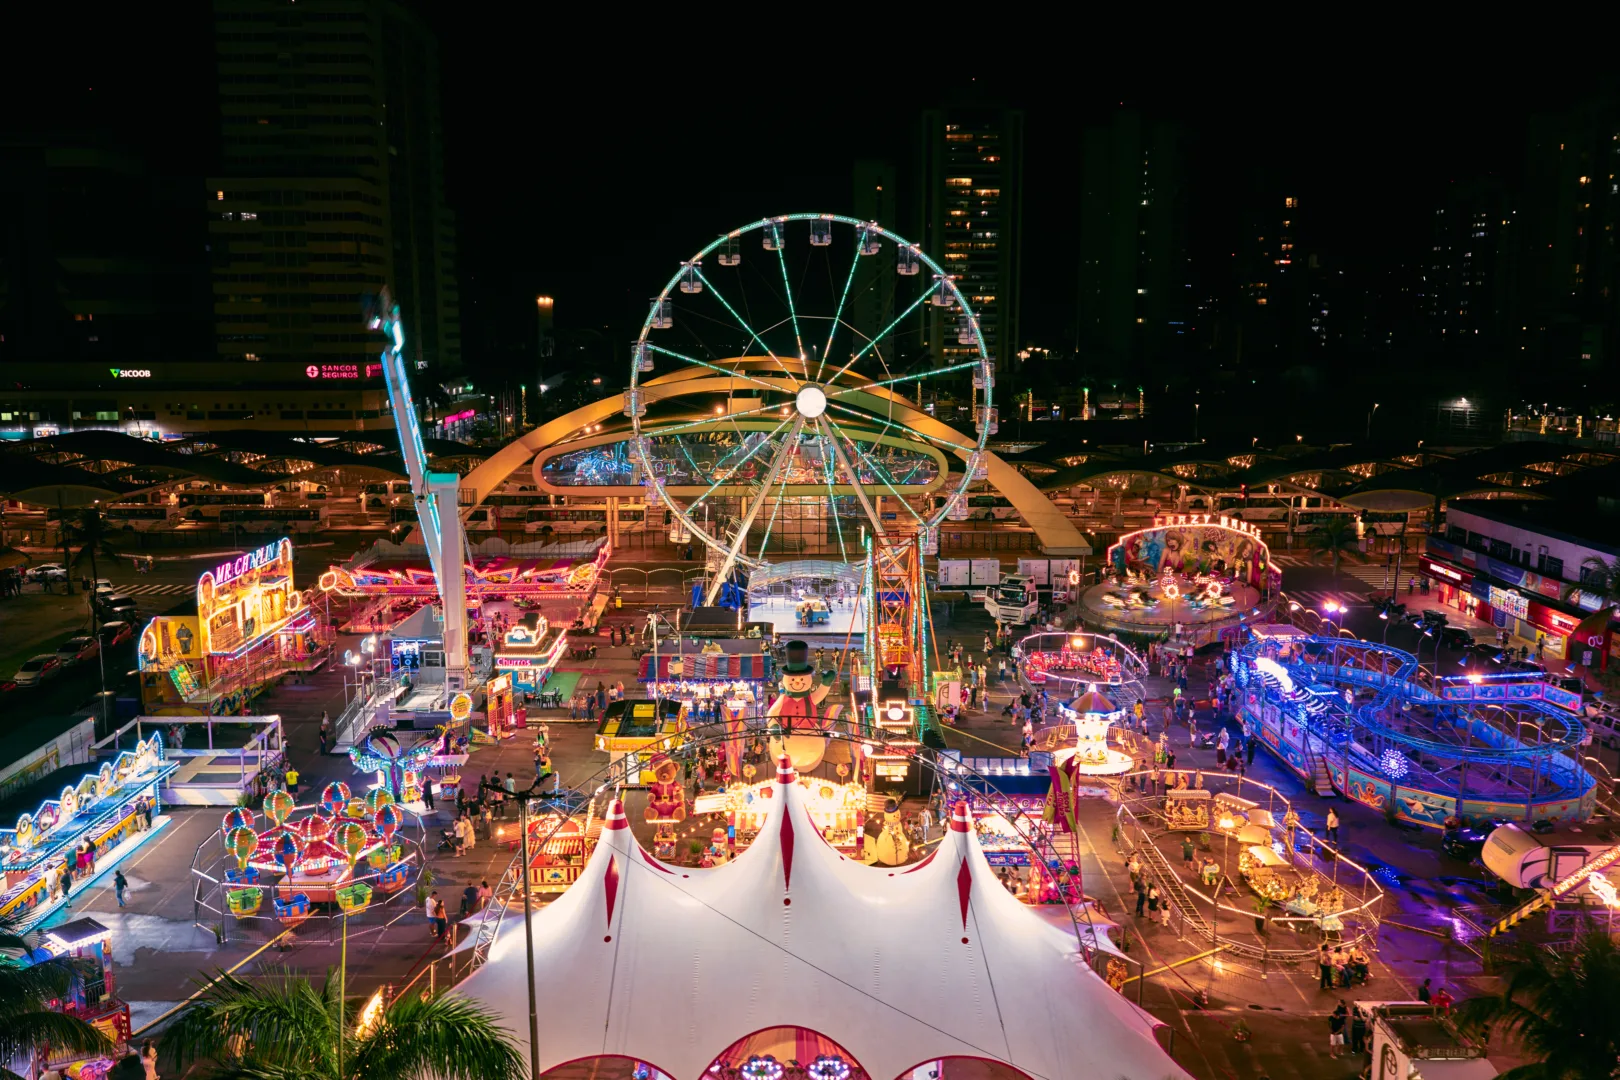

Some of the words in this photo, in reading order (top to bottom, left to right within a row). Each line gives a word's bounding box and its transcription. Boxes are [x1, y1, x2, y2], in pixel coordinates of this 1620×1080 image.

[120, 369, 151, 378] SICOOB
[322, 371, 358, 379] SEGUROS
[1154, 514, 1212, 528] CRAZY
[1220, 516, 1262, 540] DANCE
[234, 541, 276, 576] CHAPLIN
[497, 657, 532, 667] Churros
